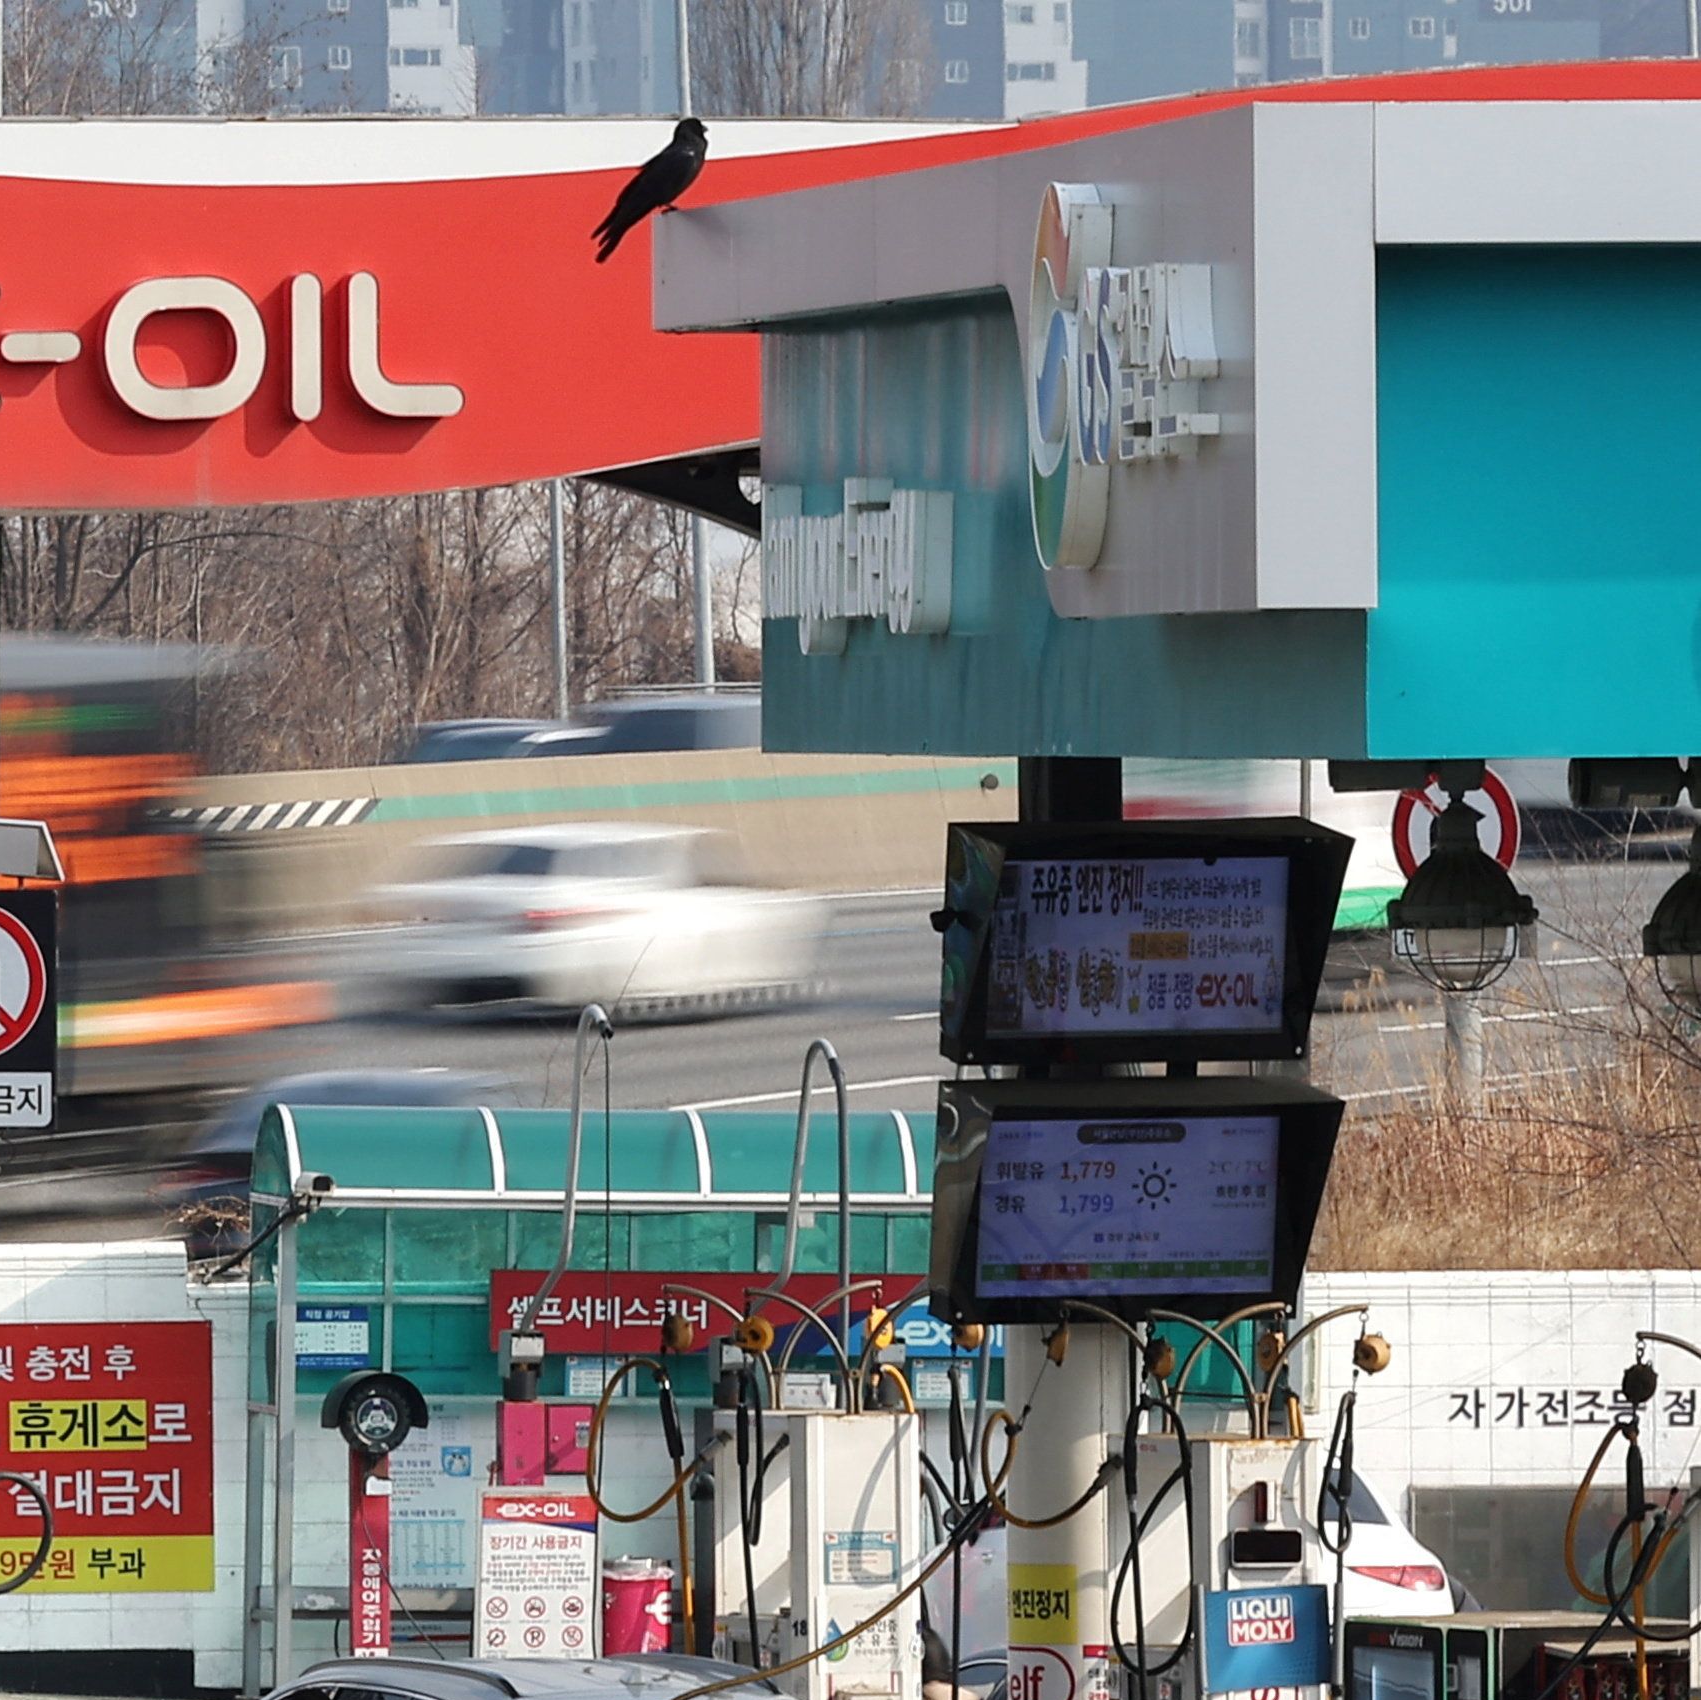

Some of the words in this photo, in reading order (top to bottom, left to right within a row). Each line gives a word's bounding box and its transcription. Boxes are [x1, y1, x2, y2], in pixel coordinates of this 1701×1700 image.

[1031, 865, 1072, 916] 주유중
[1076, 865, 1103, 914] 엔진
[1108, 865, 1143, 916] 정지!!
[1195, 973, 1259, 1008] ex-OIL
[995, 1161, 1044, 1181] 휘발유
[1061, 1161, 1116, 1183] 1,779
[1058, 1194, 1115, 1217] 1,799
[506, 1295, 708, 1330] 셀프서비스코너
[26, 1343, 92, 1381] 충전
[103, 1343, 137, 1381] 후
[13, 1402, 193, 1450] 휴게소로
[7, 1468, 182, 1517] 절대금지
[496, 1502, 576, 1518] ex-OIL
[489, 1535, 527, 1550] 장기간
[532, 1534, 582, 1550] 사용금지
[0, 1549, 77, 1579] 9만원
[88, 1547, 146, 1579] 부과
[1232, 1597, 1289, 1619] LIQUI
[792, 1620, 808, 1637] 18
[1232, 1619, 1291, 1643] MOLY
